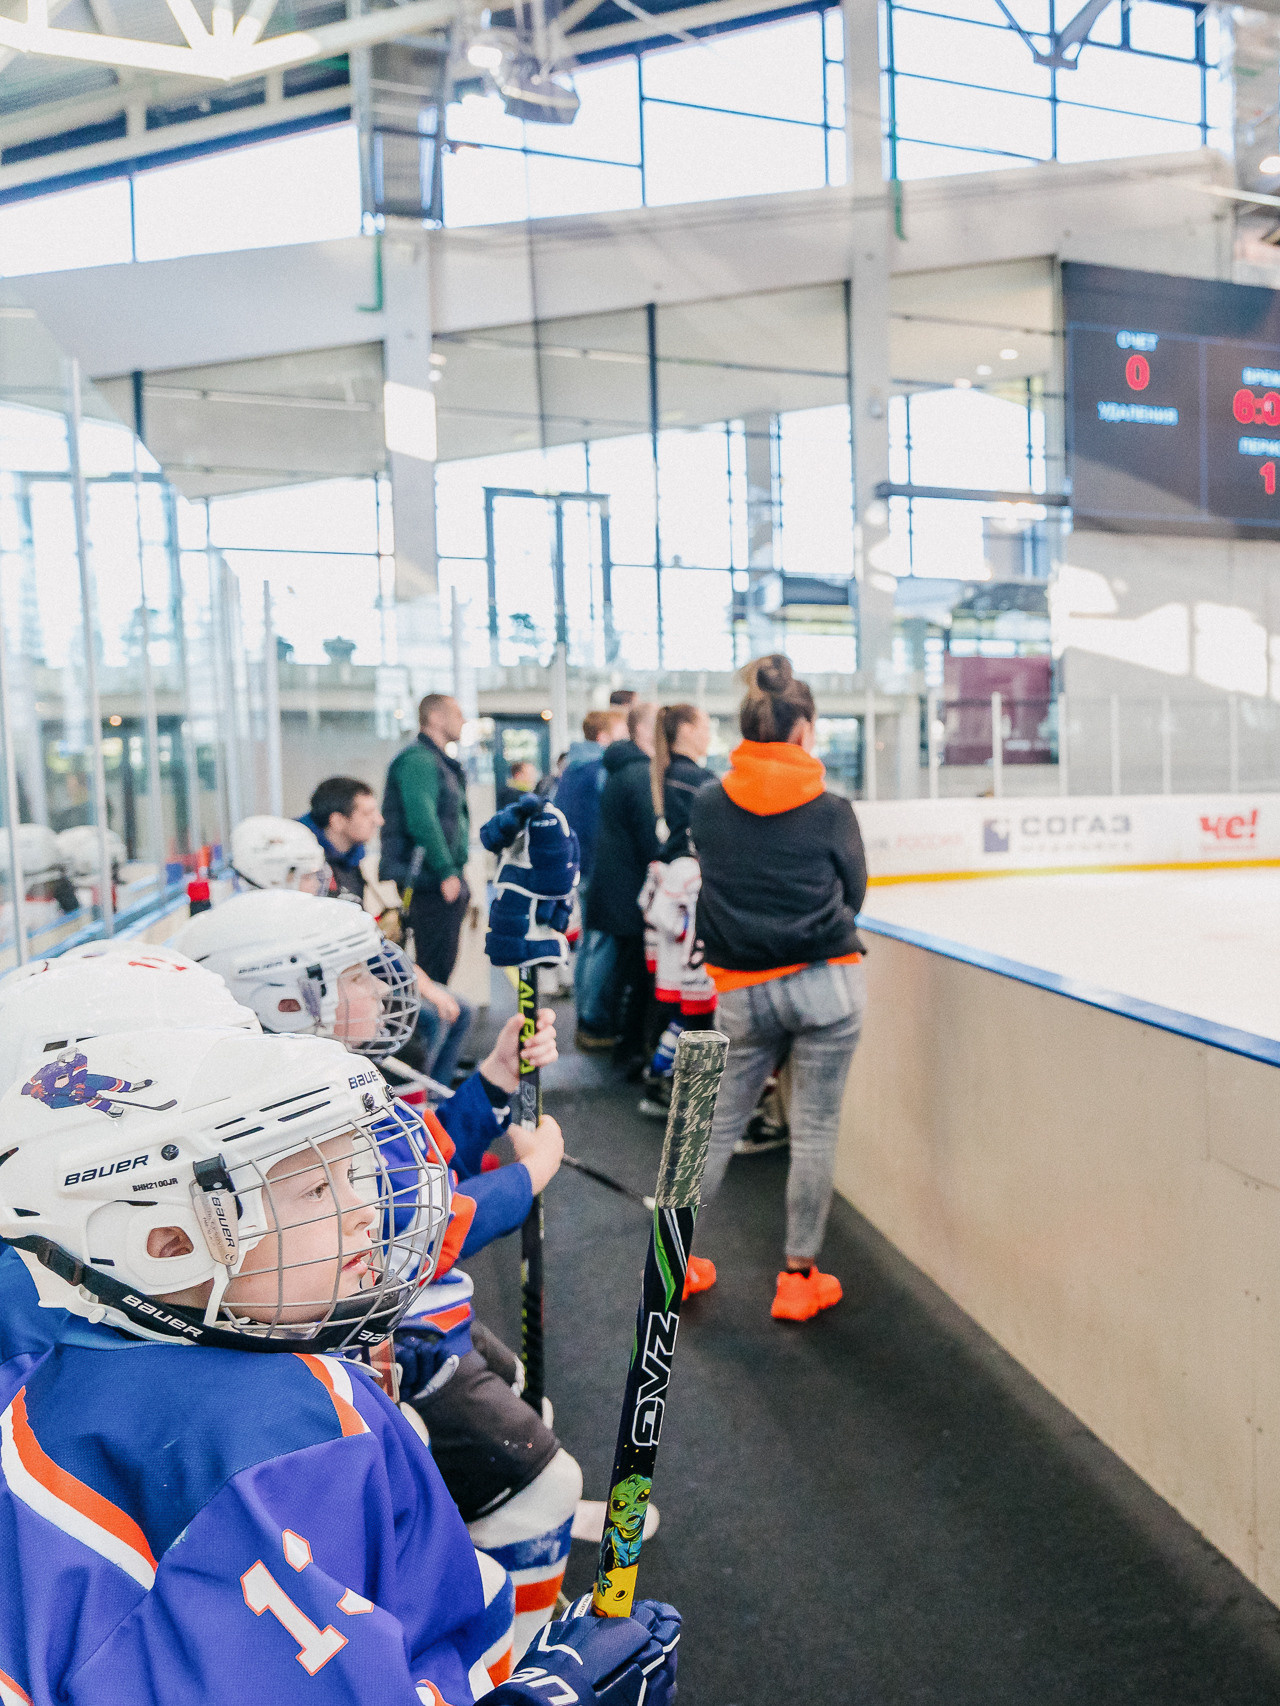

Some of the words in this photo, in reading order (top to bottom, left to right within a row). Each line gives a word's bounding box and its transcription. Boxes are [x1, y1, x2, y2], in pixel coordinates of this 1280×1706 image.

[1125, 354, 1150, 391] 0
[1260, 461, 1277, 495] 1
[1020, 813, 1132, 836] СОГАЗ
[63, 1154, 149, 1187] BAUER
[211, 1196, 236, 1248] BAUER
[121, 1294, 204, 1339] BAUER
